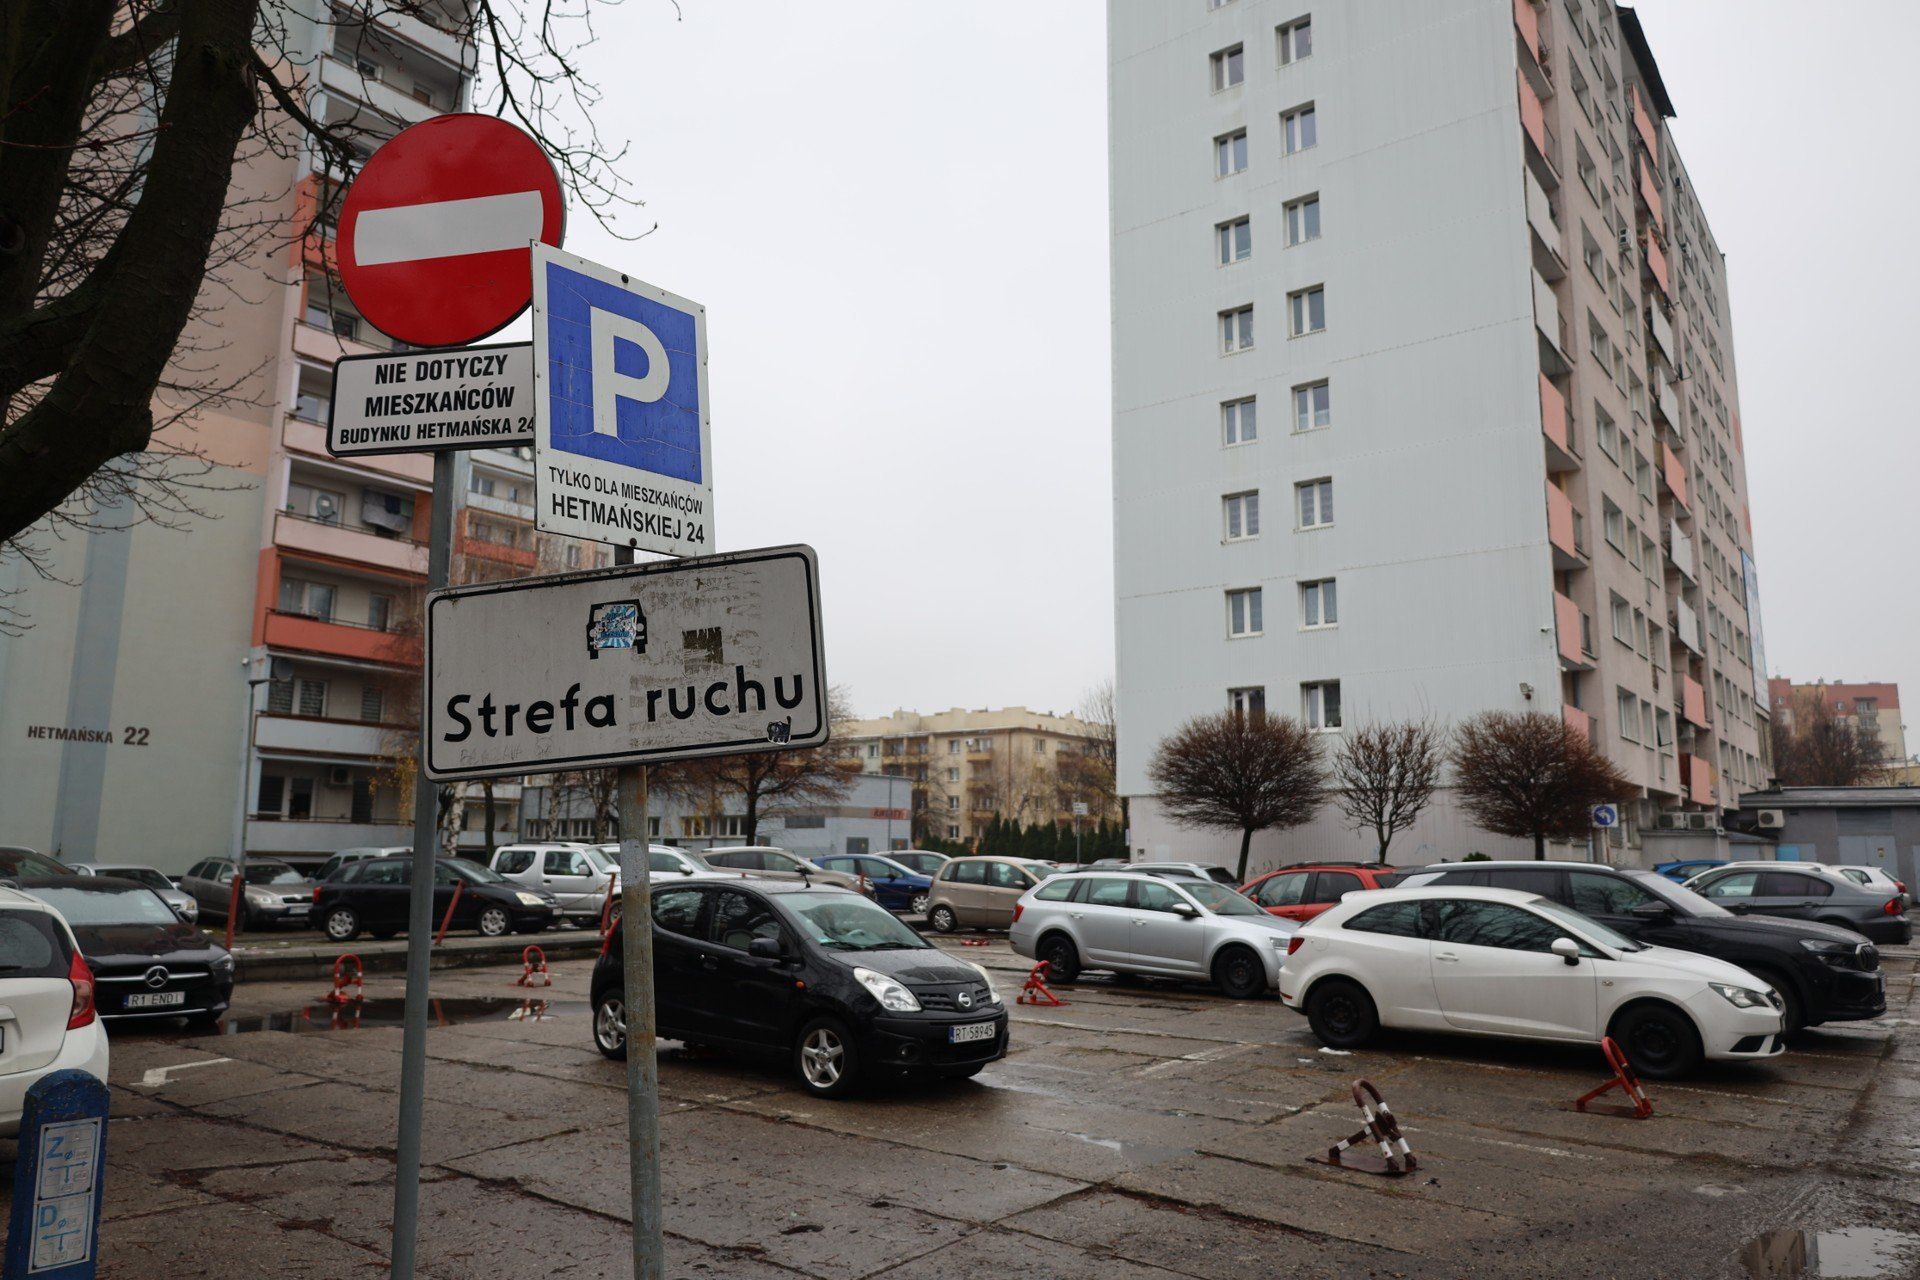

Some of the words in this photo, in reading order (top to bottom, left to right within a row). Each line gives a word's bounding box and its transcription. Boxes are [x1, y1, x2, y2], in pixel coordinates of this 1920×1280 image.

[375, 363, 407, 384] NIE
[415, 354, 508, 382] DOTYCZY
[590, 305, 670, 438] P
[364, 382, 515, 417] MIESZKAŃCÓW
[340, 425, 410, 445] BUDYNKU
[416, 415, 511, 440] HETMAŃSKA
[549, 466, 591, 490] TYLKO
[595, 477, 619, 496] DLA
[621, 482, 703, 515] MIESZKAŃCÓW
[552, 493, 681, 540] HETMAŃSKIEJ
[686, 521, 705, 545] 24
[443, 682, 617, 743] Strefa
[646, 665, 802, 722] ruchu
[27, 725, 114, 744] HETMAŃSKA
[123, 726, 150, 746] 22
[955, 1028, 966, 1041] RT
[969, 1024, 993, 1039] 58945
[45, 1136, 64, 1159] Z
[39, 1205, 58, 1228] D
